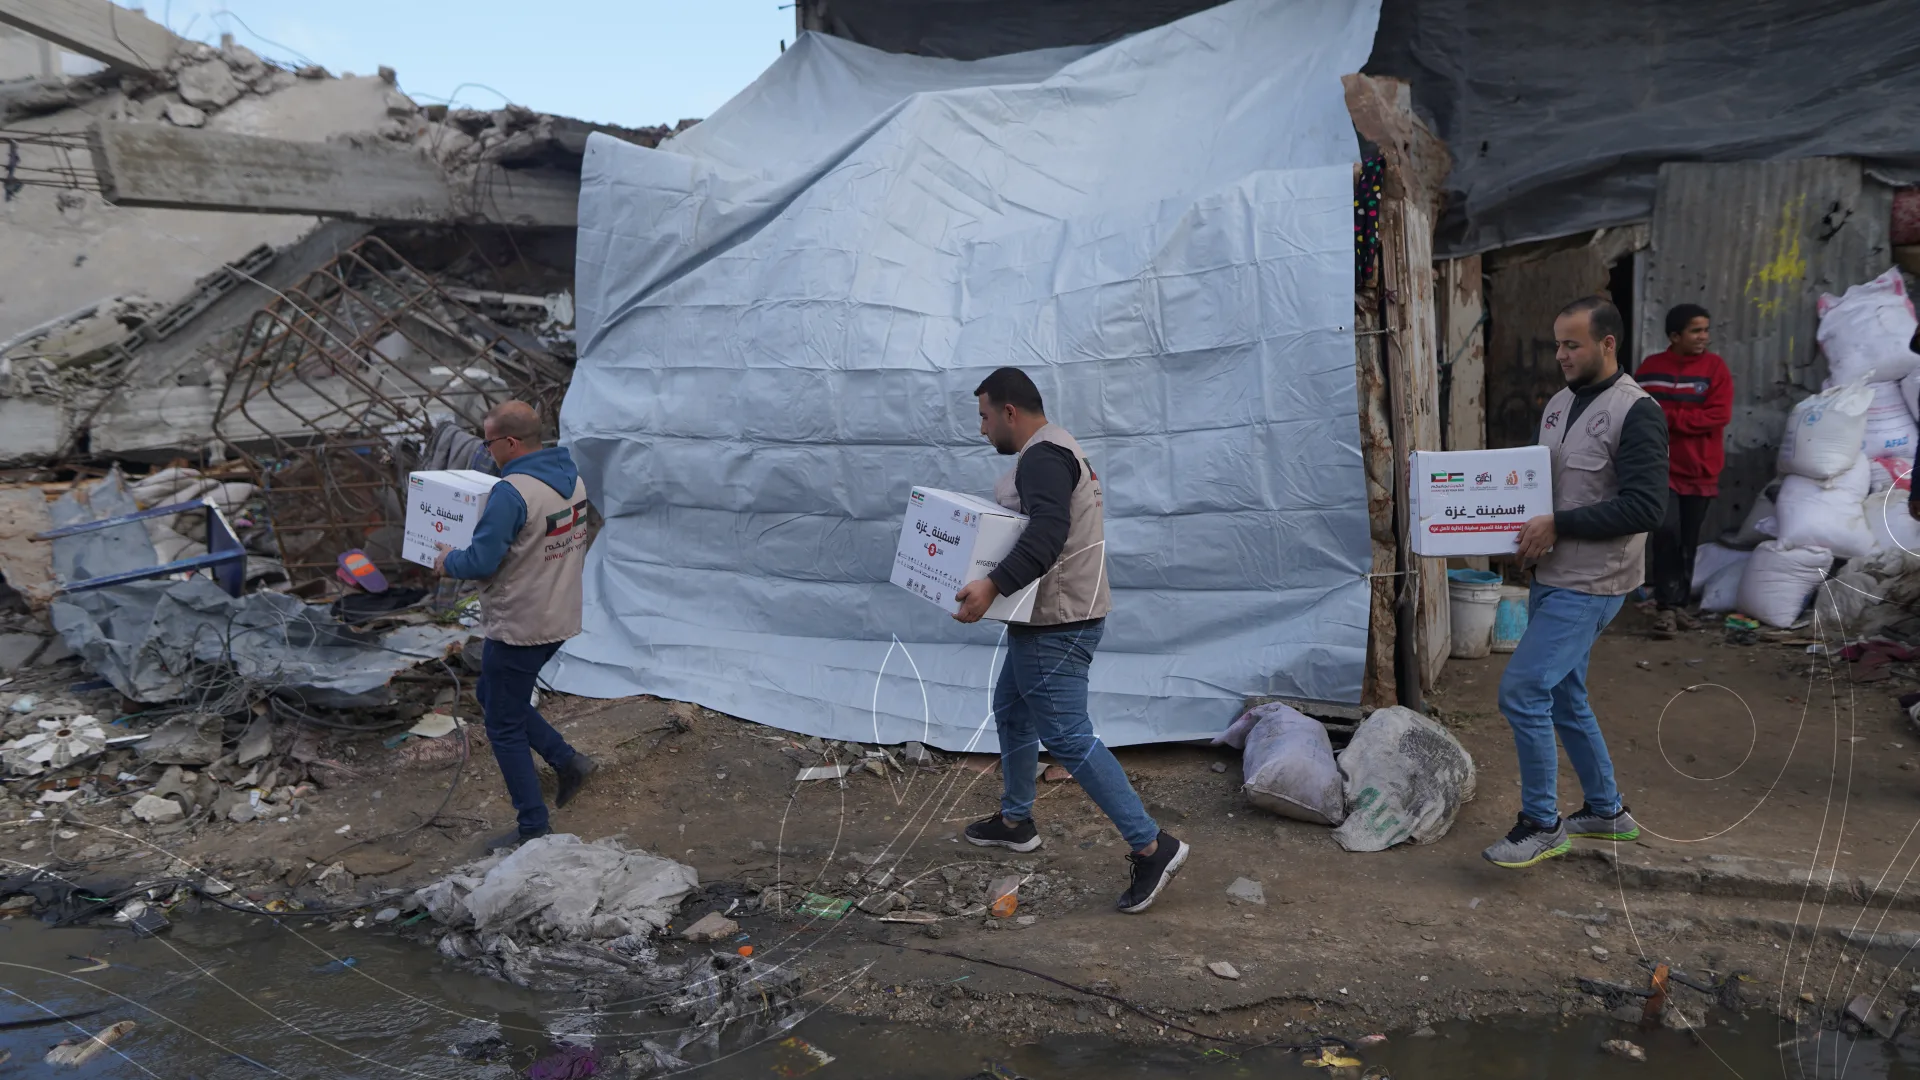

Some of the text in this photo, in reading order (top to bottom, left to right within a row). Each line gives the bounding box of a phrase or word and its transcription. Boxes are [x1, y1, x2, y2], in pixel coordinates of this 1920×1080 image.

[1445, 504, 1526, 520] #سفينة_غزة
[915, 519, 961, 546] #سفينة_غزة
[976, 559, 998, 568] HYGIENE
